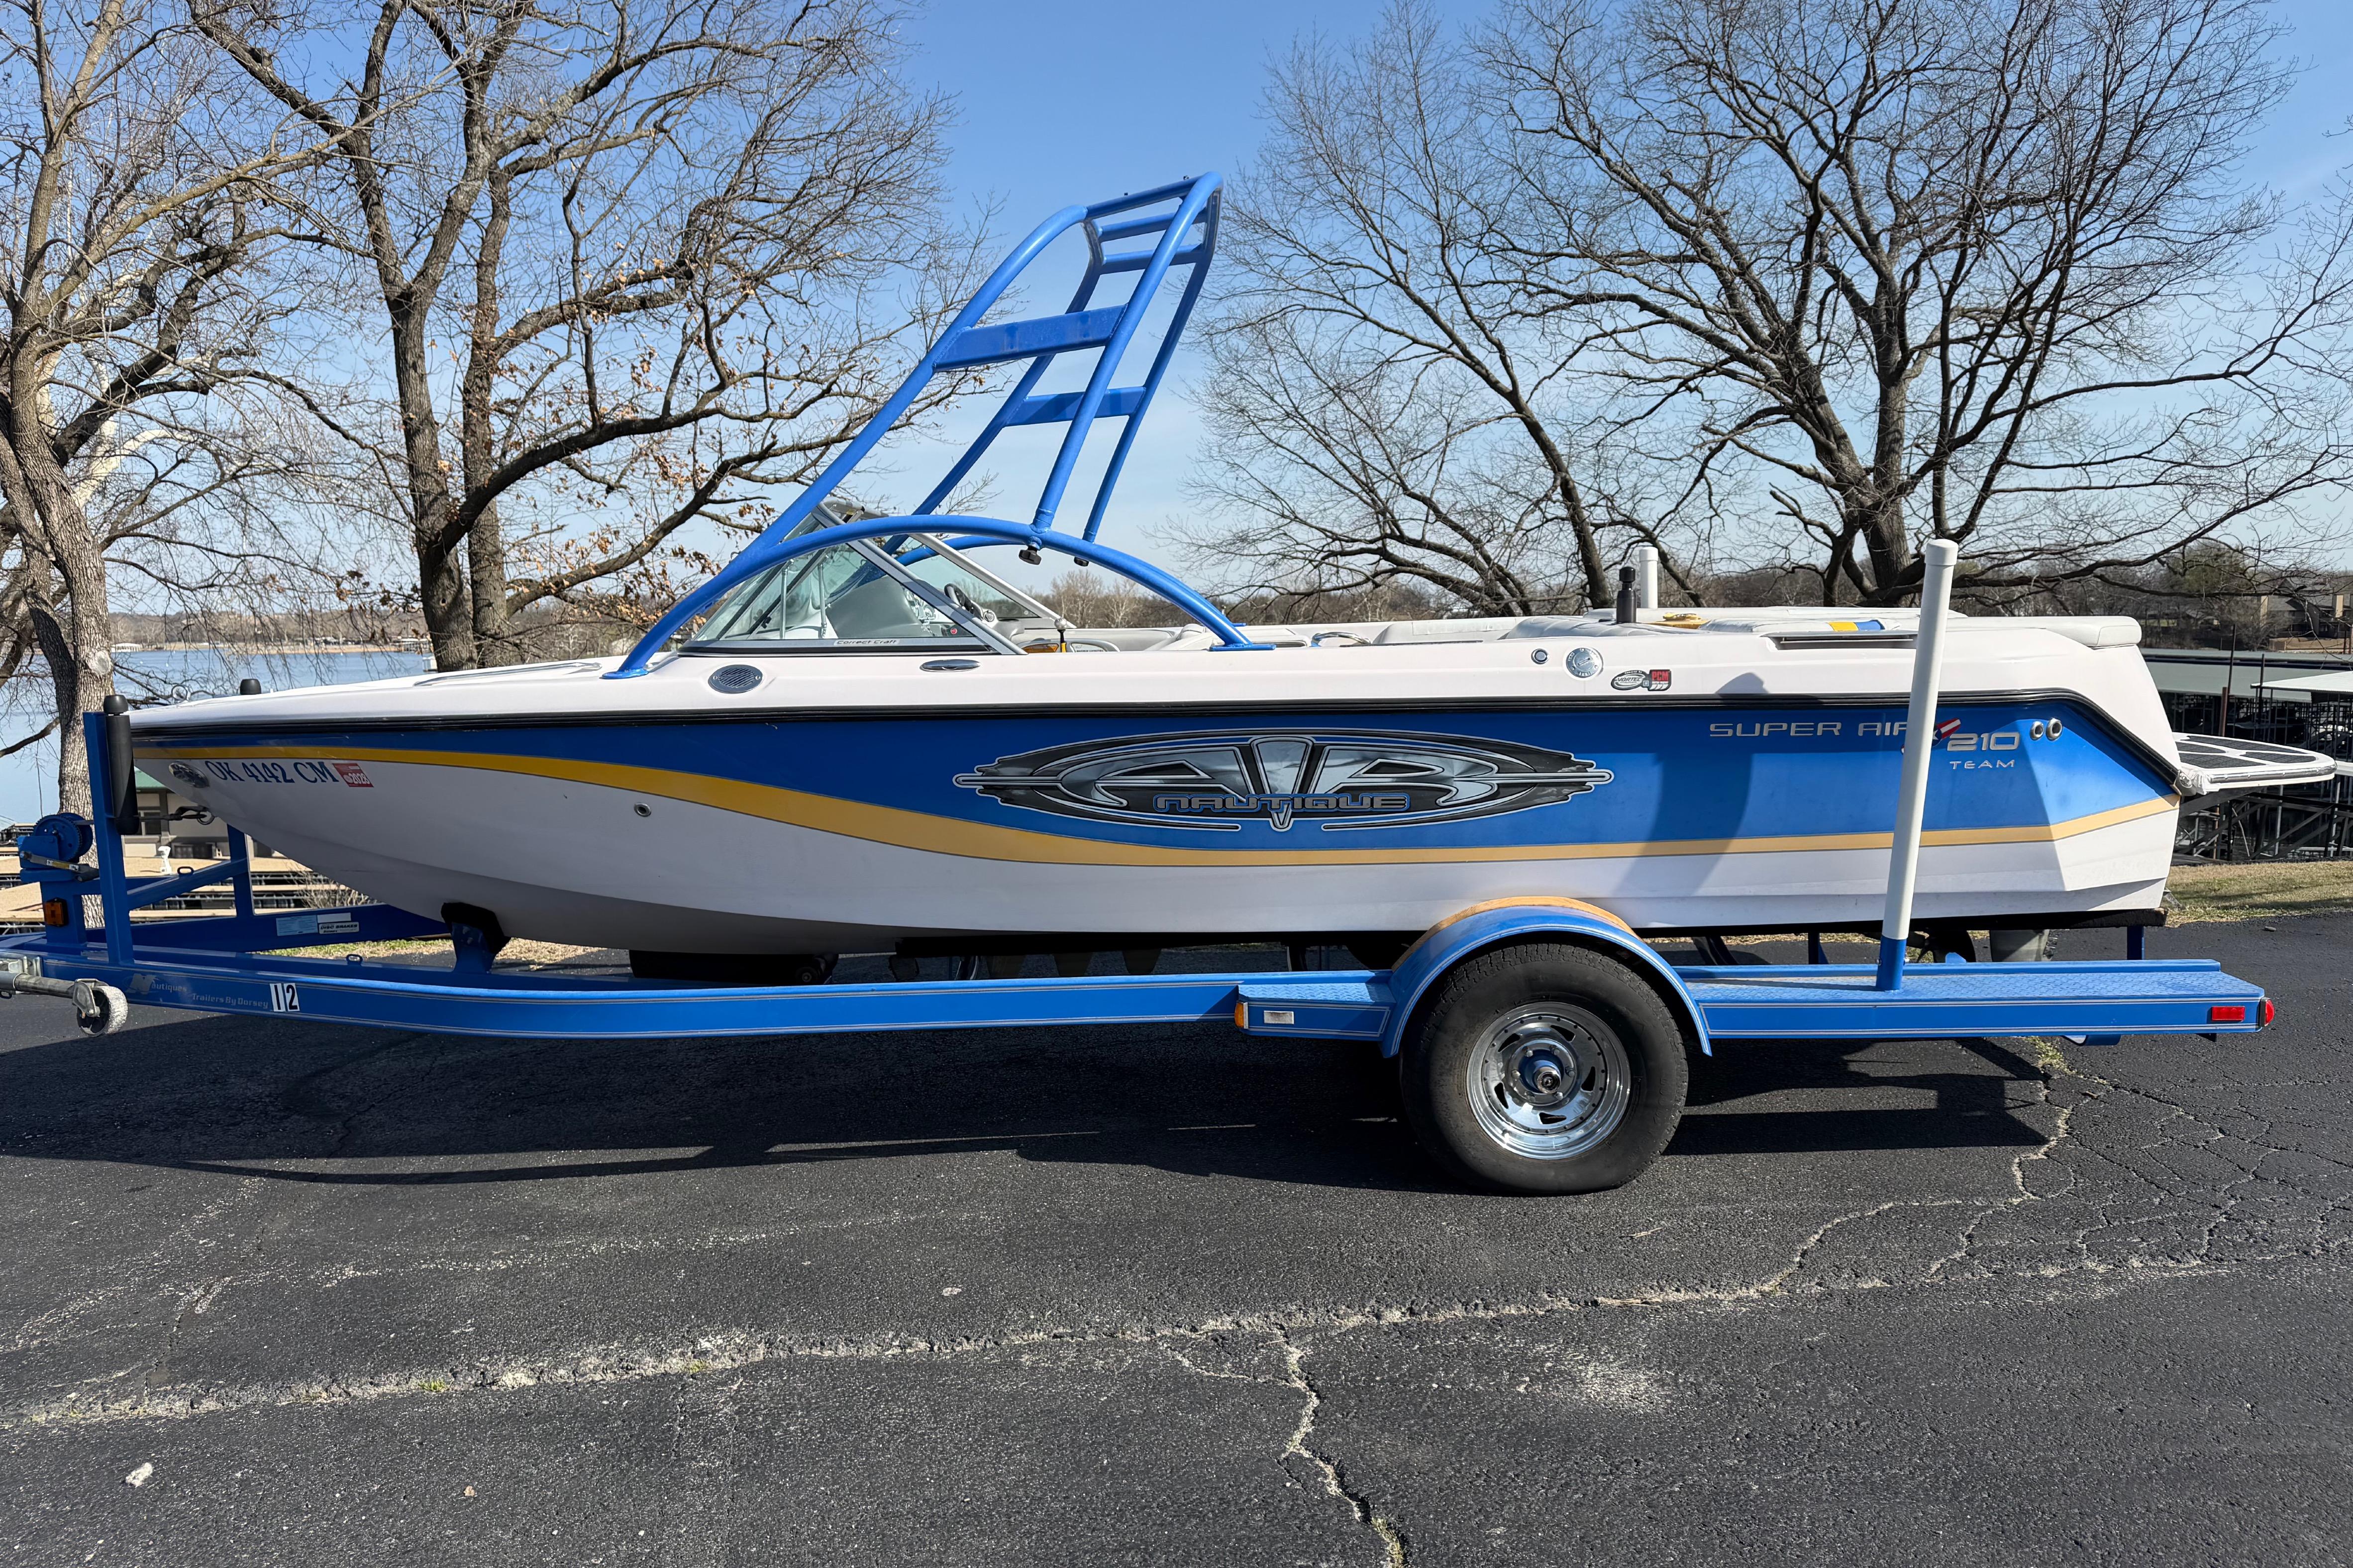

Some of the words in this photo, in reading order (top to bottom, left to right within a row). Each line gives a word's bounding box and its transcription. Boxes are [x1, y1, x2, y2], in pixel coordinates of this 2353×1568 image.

[1652, 671, 1669, 682] PCM
[1710, 722, 1841, 737] SUPER
[1947, 732, 2020, 751] 210
[205, 761, 245, 782] OK
[241, 762, 295, 784] 4142
[293, 761, 339, 783] CM
[1949, 760, 2015, 770] TEAM
[348, 773, 371, 784] 2028
[1155, 795, 1409, 811] NAUTIQUE
[191, 993, 224, 1003] Trailers
[225, 996, 236, 1006] By
[237, 997, 269, 1009] Dorsey
[274, 984, 298, 1010] 12
